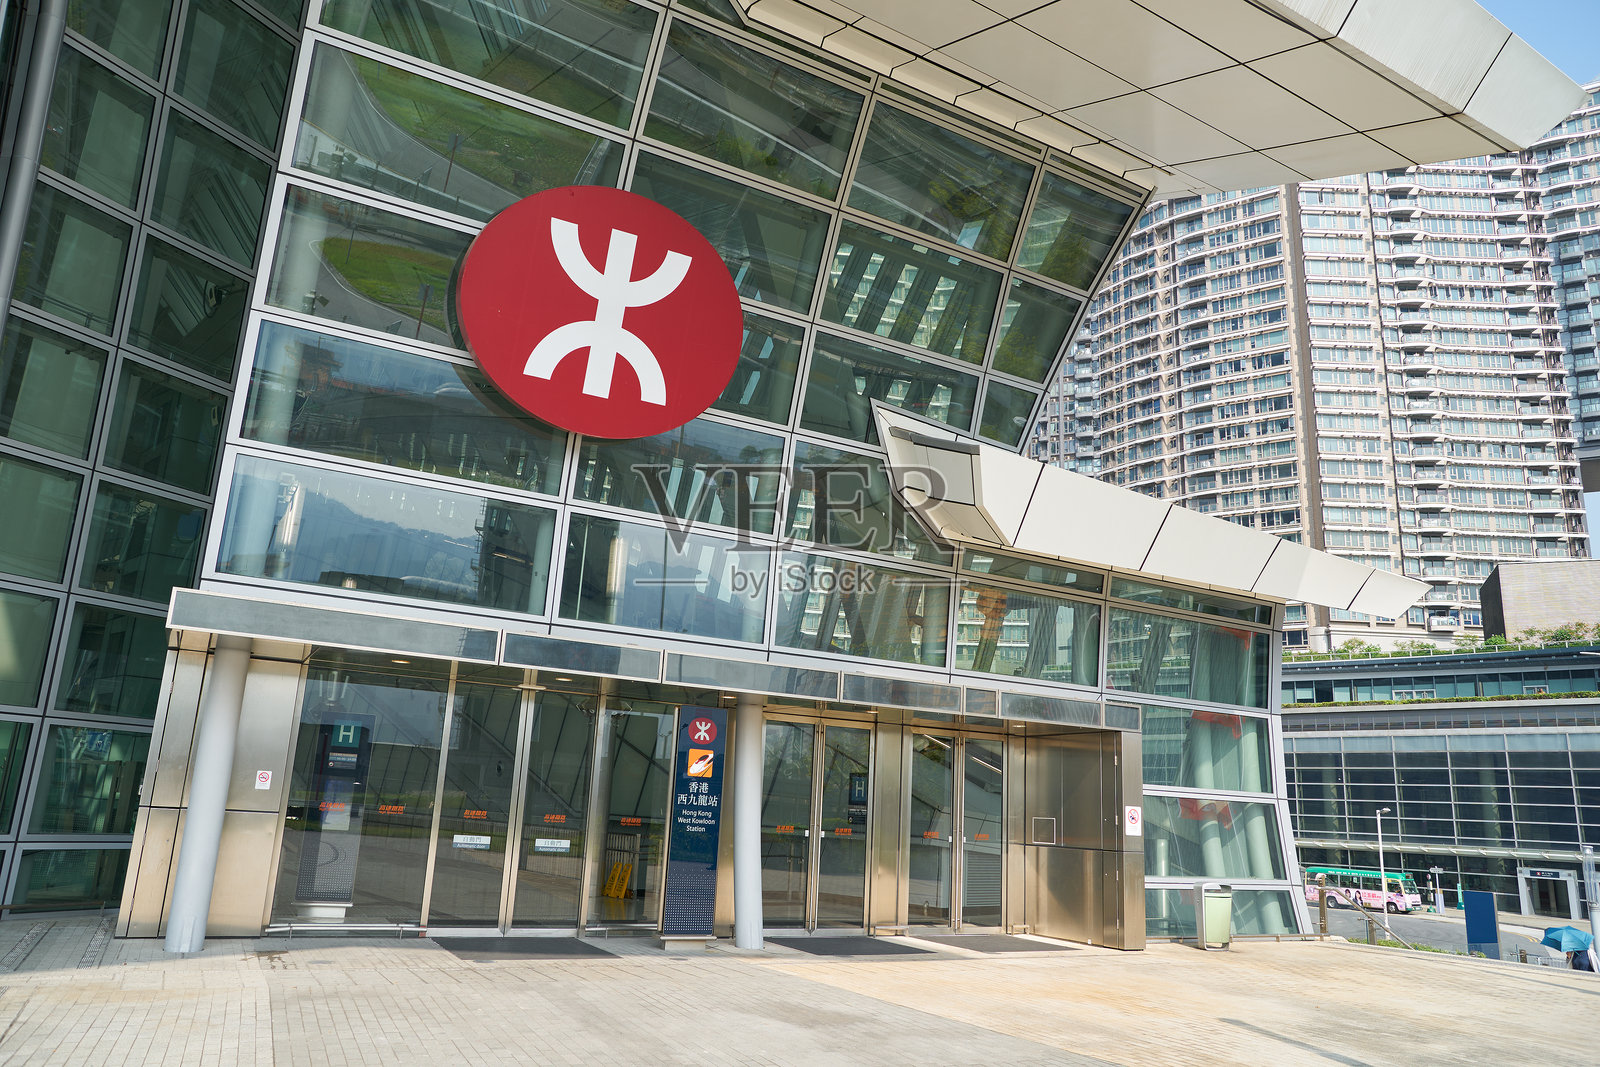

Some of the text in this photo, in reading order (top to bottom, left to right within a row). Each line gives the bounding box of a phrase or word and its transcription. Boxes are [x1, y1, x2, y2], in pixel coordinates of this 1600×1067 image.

[338, 724, 354, 743] H
[689, 782, 709, 793] 香港
[856, 781, 864, 798] H
[677, 794, 718, 806] 西九龍站
[698, 810, 712, 818] Kong
